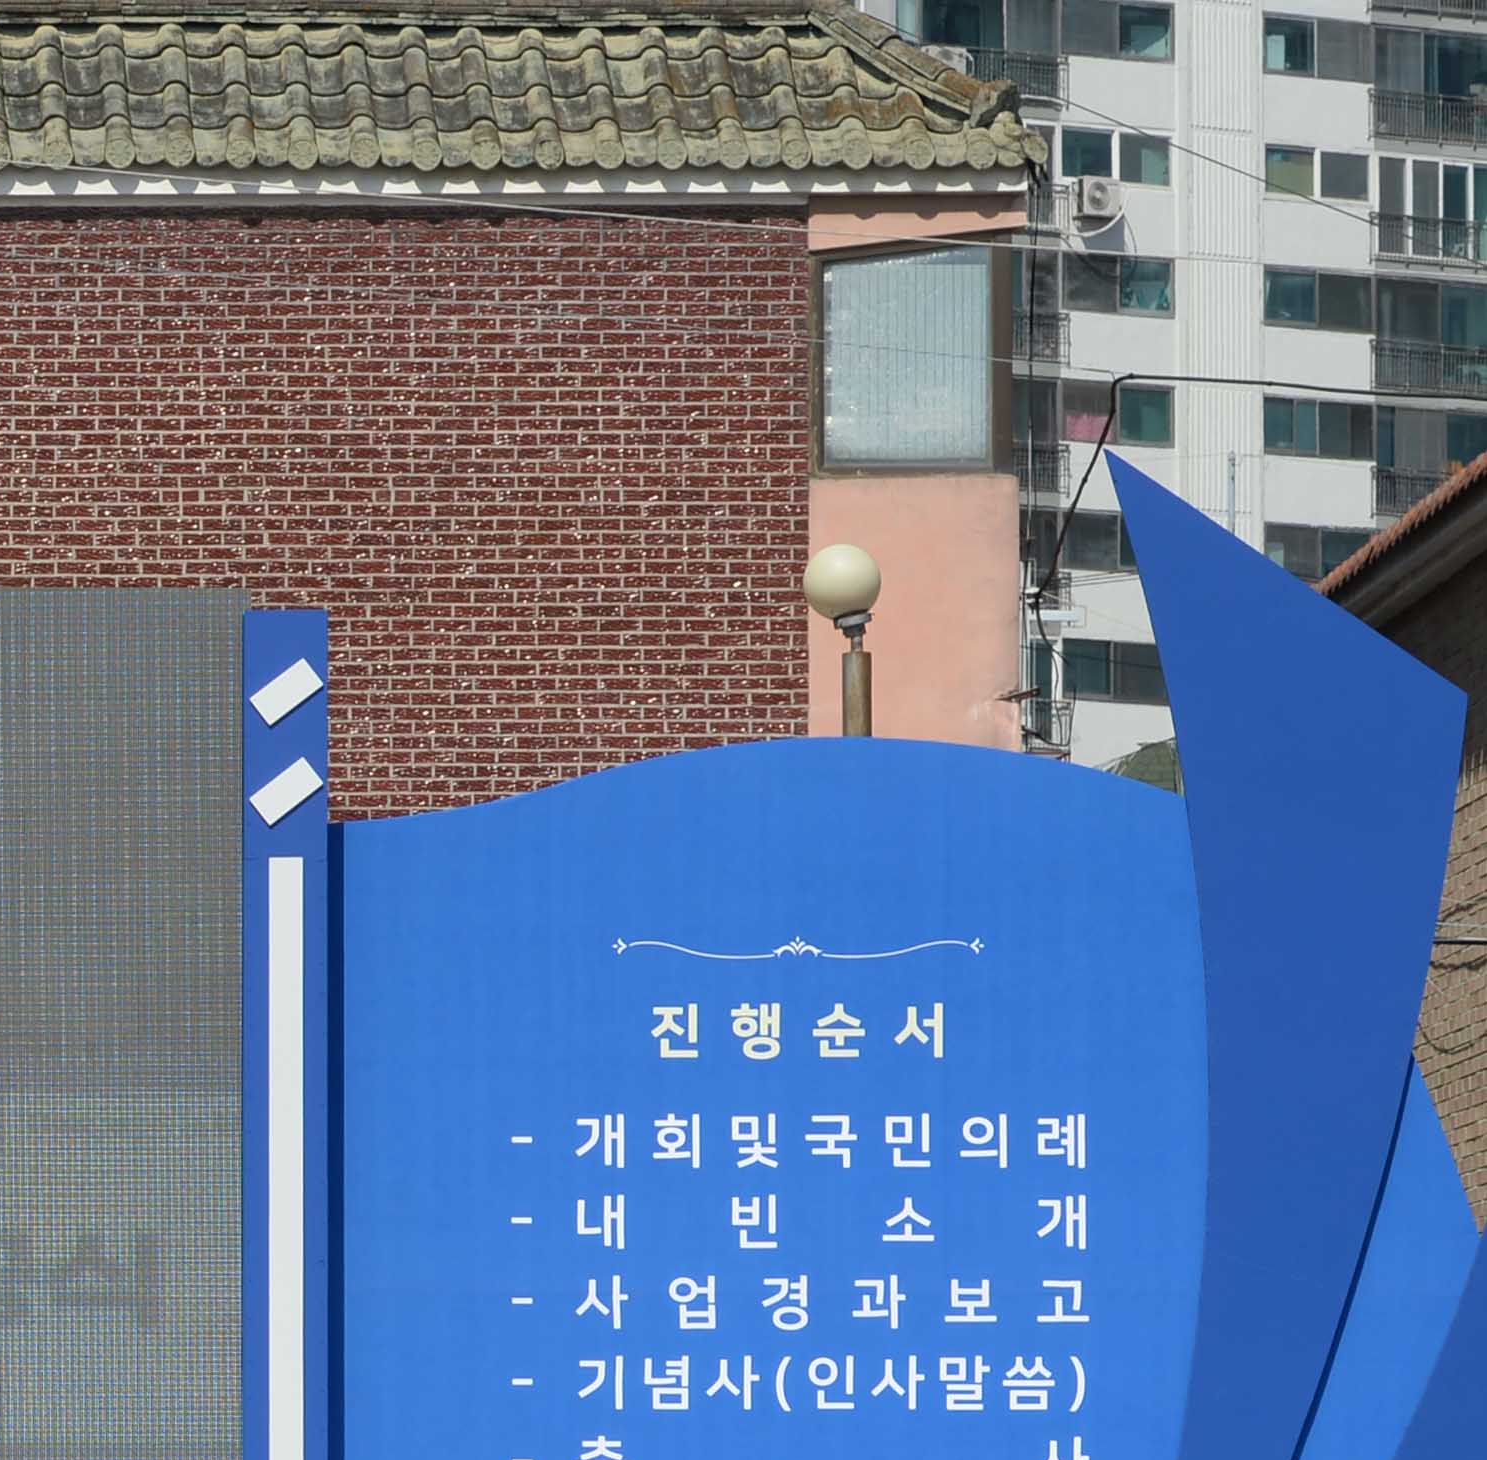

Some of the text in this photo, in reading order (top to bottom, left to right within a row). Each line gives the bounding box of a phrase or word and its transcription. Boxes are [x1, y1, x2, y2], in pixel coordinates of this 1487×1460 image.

[650, 1001, 945, 1060] 진행순서
[574, 1112, 1087, 1169] 개회및국민의례
[574, 1273, 1090, 1330] 사업경과보고
[577, 1354, 1087, 1412] 기념사(인사말씀)
